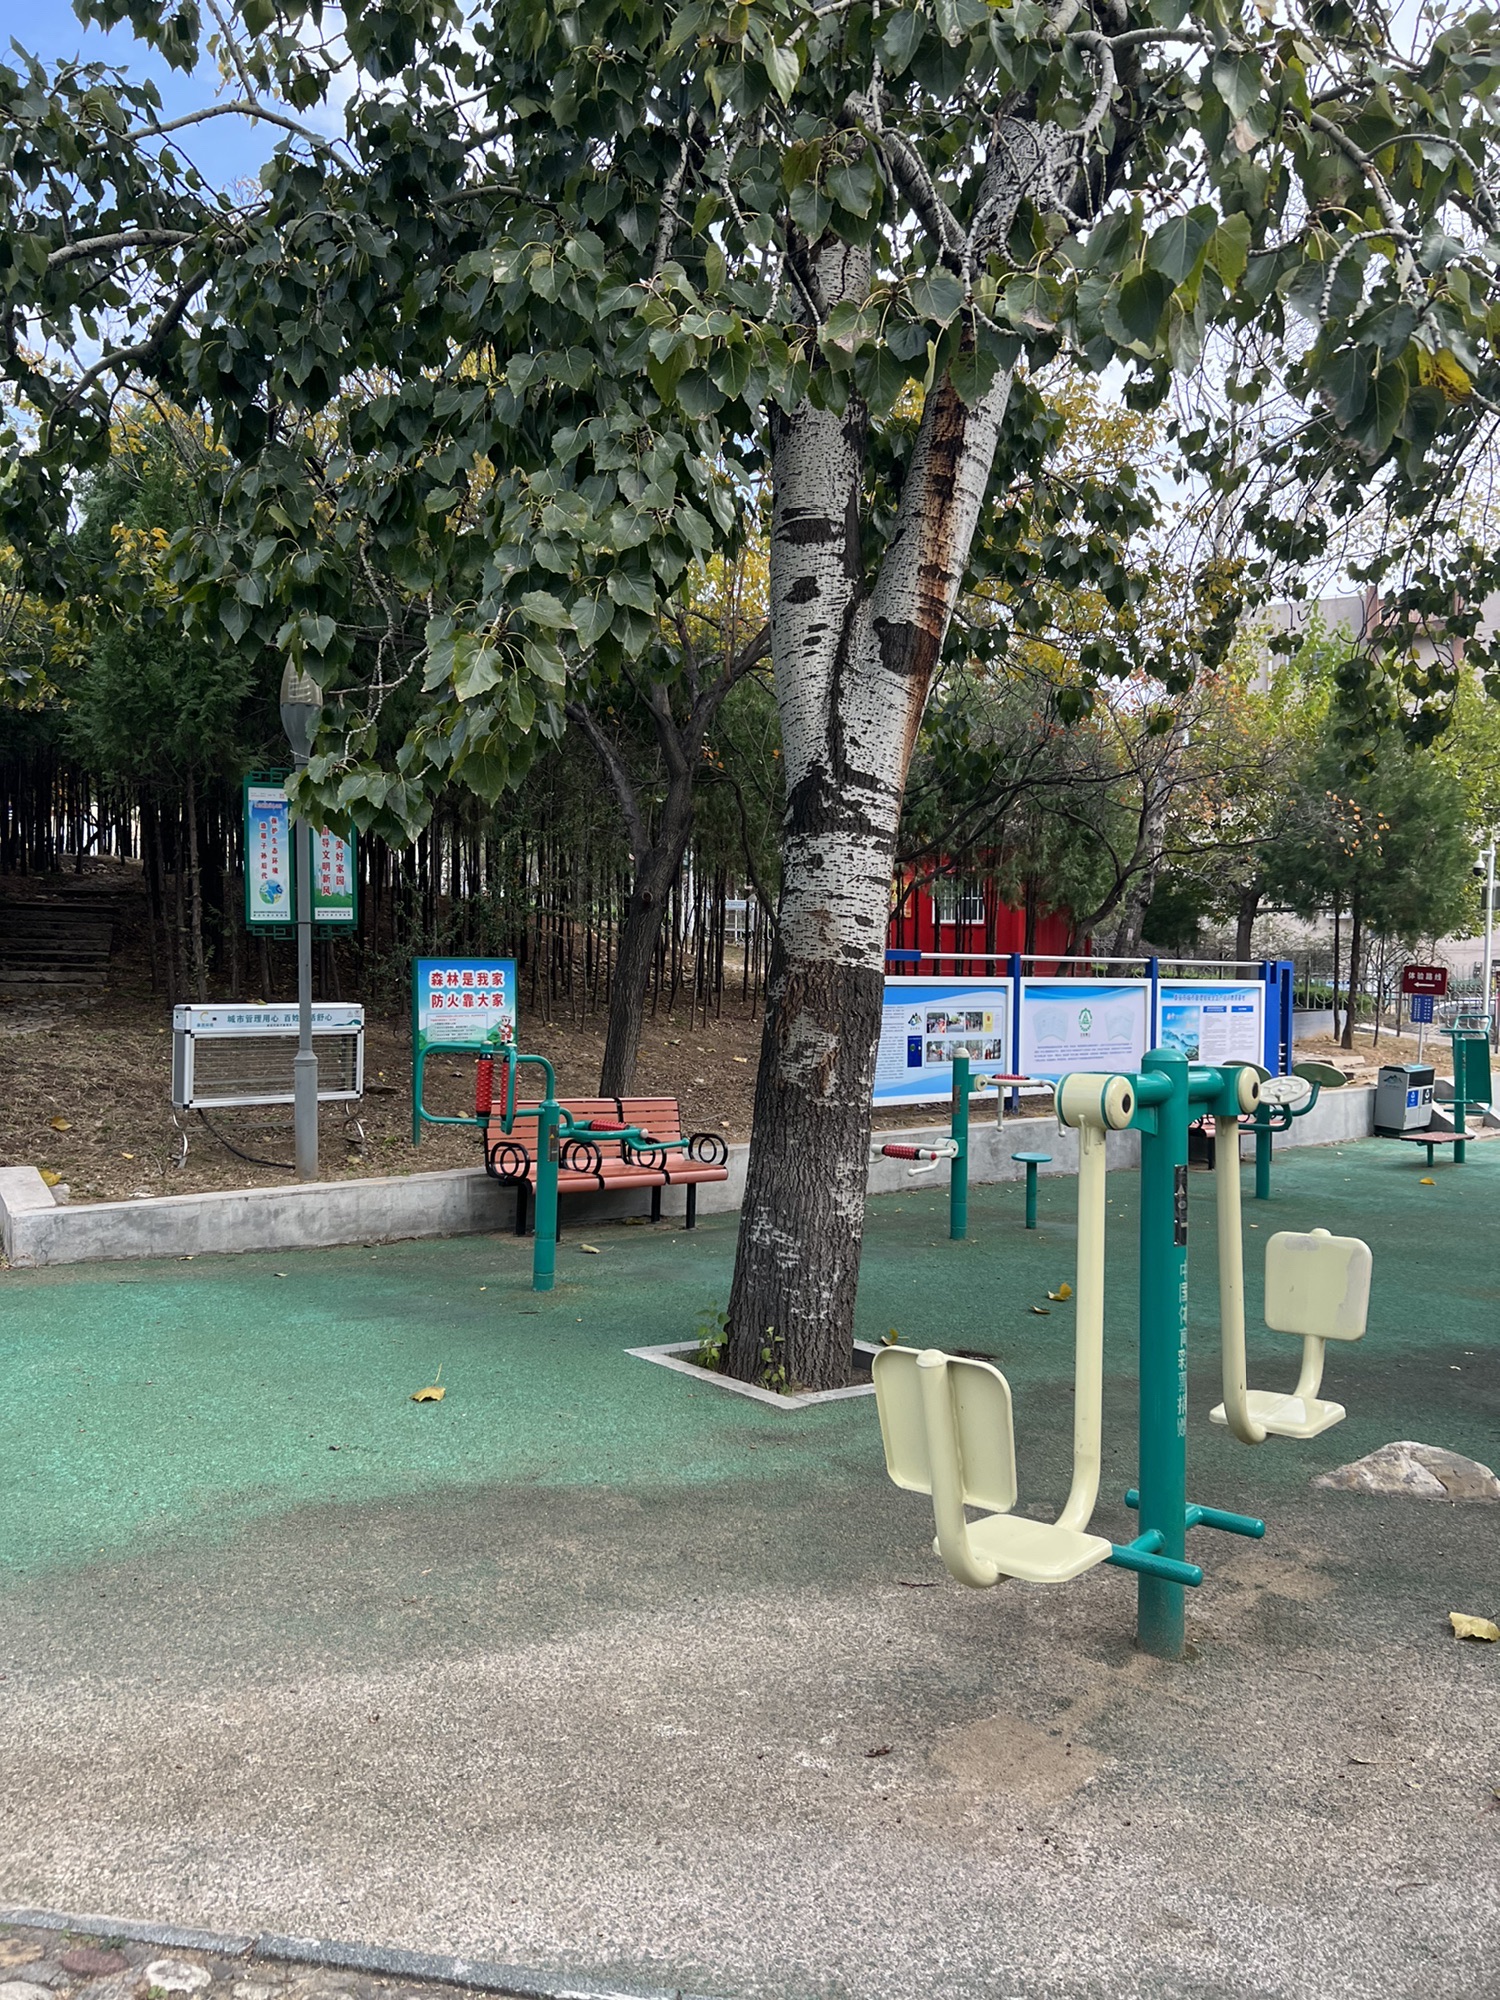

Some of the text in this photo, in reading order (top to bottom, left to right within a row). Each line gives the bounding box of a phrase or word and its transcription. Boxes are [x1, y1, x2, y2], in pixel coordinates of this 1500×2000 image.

[431, 971, 503, 986] 森林是我家
[1407, 971, 1442, 981] 体验路线
[431, 993, 503, 1008] 防火靠大家
[227, 1013, 333, 1023] 城市管理用心 百姓活舒心
